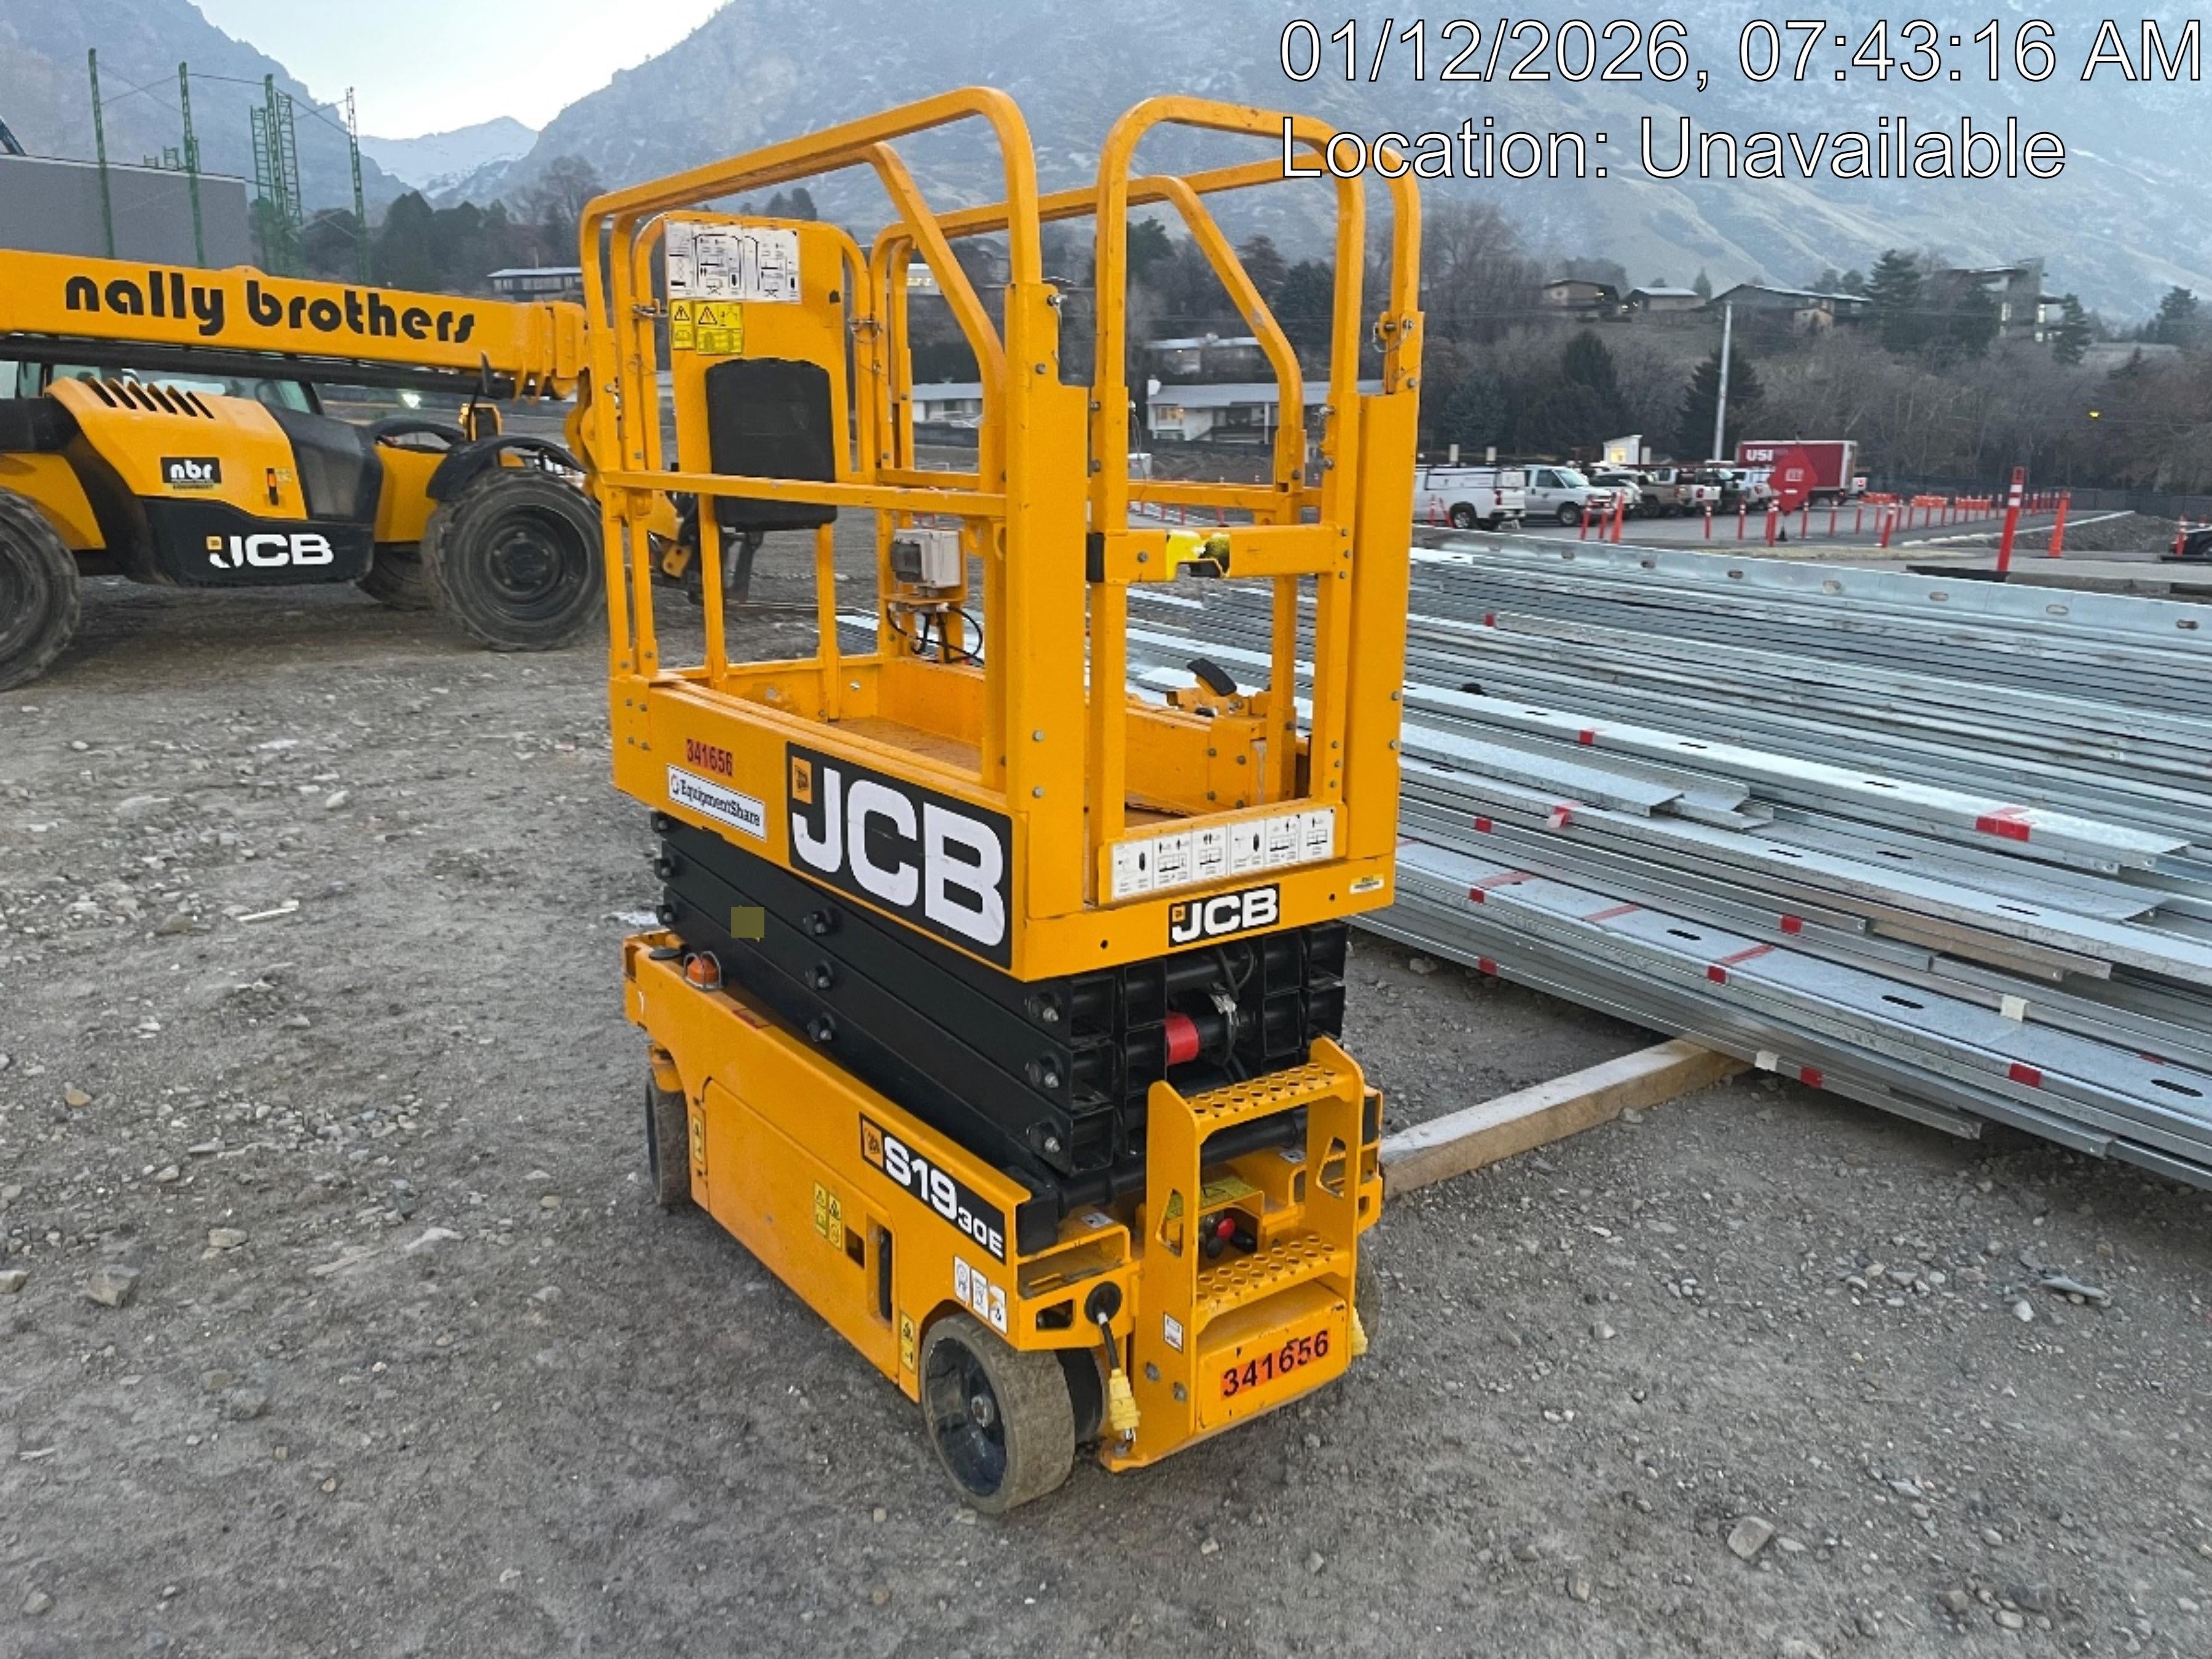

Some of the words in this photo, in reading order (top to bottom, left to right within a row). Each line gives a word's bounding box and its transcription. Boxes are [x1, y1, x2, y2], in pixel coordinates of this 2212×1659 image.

[65, 271, 226, 336] nally
[248, 280, 476, 344] brothers
[170, 459, 212, 479] nbr
[1746, 449, 1774, 461] USI
[208, 533, 334, 569] JCB
[686, 739, 733, 777] 341656
[680, 779, 761, 826] EquipmentShare
[791, 766, 1006, 947] JCB
[1172, 888, 1277, 943] JCB
[1223, 1330, 1328, 1397] 341656
